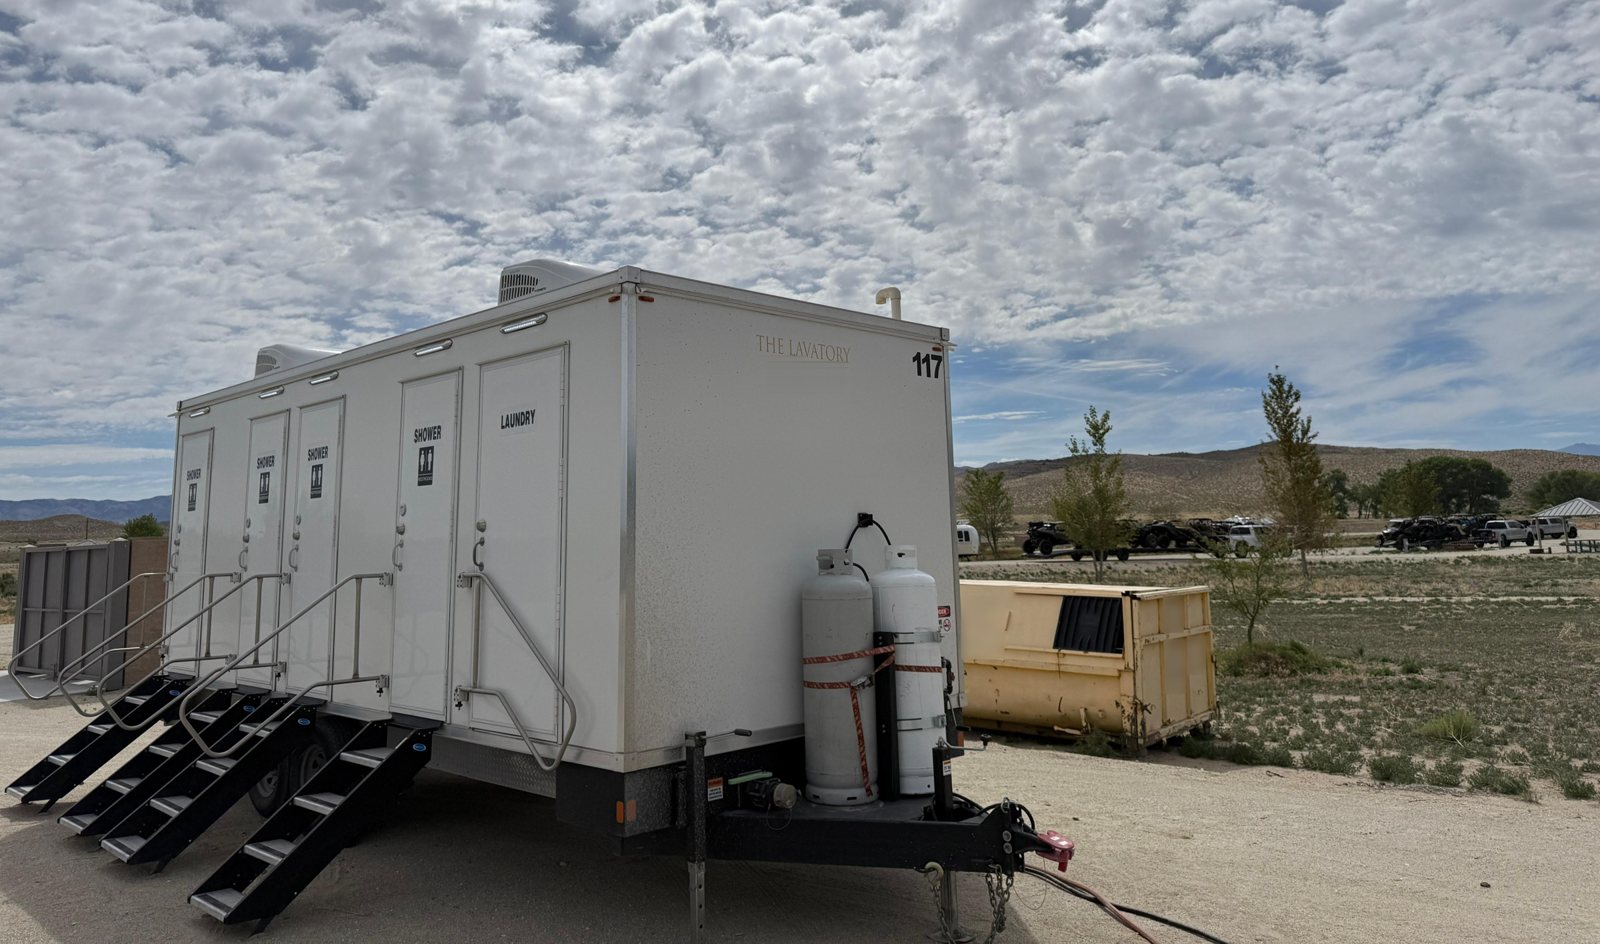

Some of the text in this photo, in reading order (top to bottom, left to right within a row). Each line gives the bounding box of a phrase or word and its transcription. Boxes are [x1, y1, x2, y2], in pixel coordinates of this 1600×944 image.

[756, 334, 850, 363] THE LAVATORY
[912, 351, 942, 379] 117
[500, 409, 536, 429] LAUNDRY
[413, 425, 442, 443] SHOWER
[256, 455, 275, 469] SHOWER
[307, 445, 329, 461] SHOWER
[186, 468, 201, 481] SHOWER
